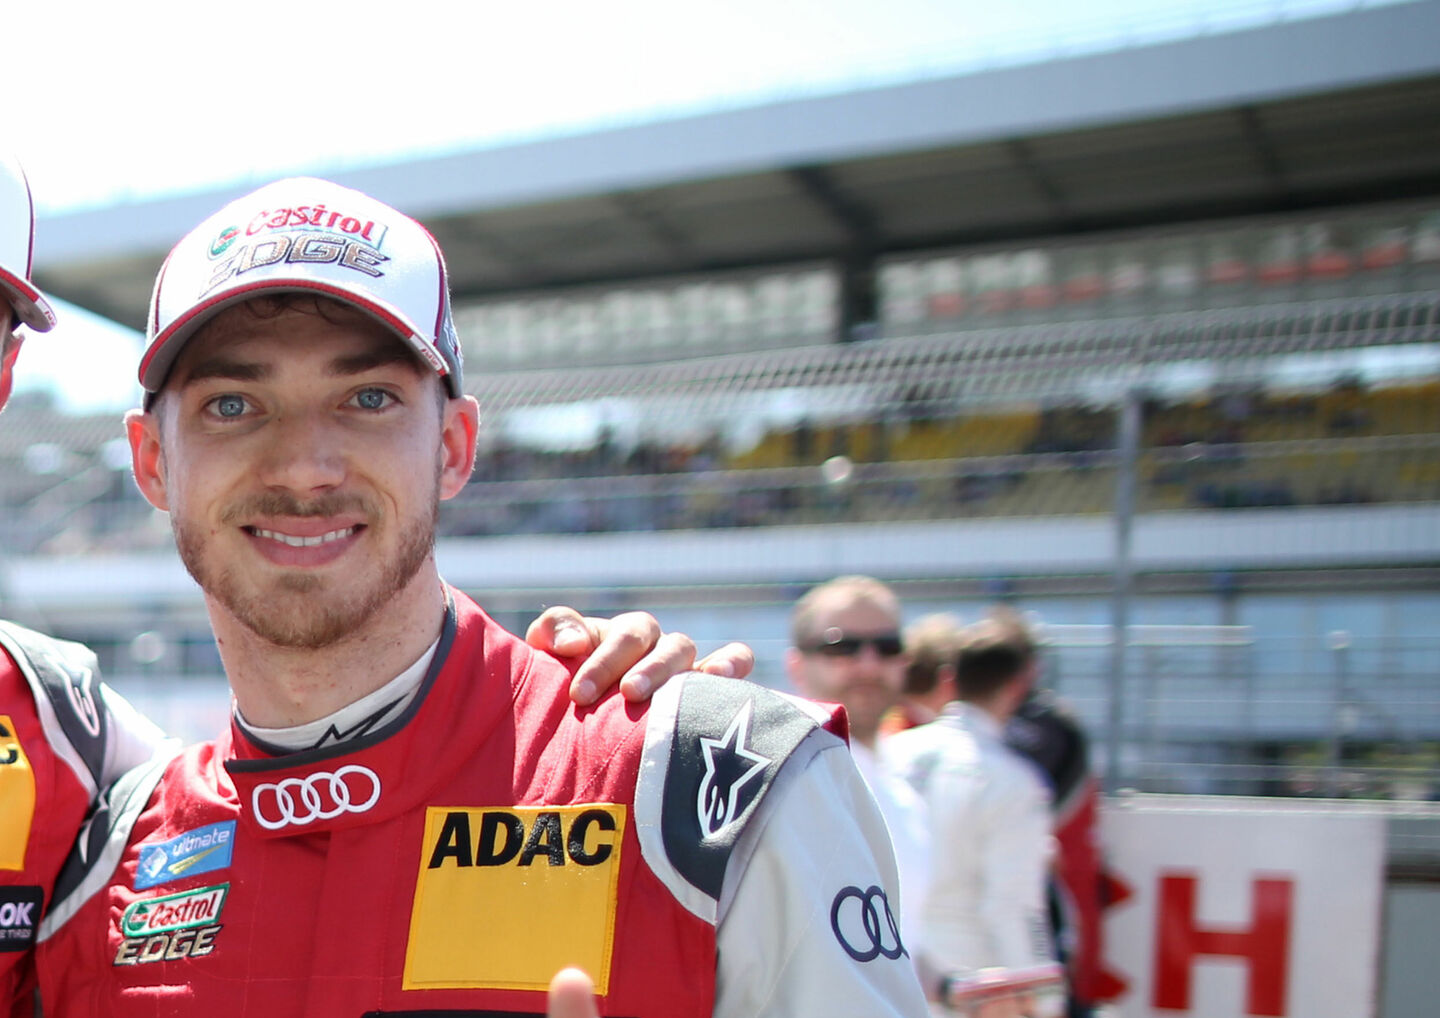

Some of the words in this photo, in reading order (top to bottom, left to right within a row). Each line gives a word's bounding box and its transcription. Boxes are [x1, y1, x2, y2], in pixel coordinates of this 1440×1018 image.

[246, 203, 377, 242] Castrol
[172, 828, 231, 857] ultimate
[428, 811, 616, 868] ADAC
[148, 892, 218, 929] Castrol
[113, 924, 224, 966] EDGE
